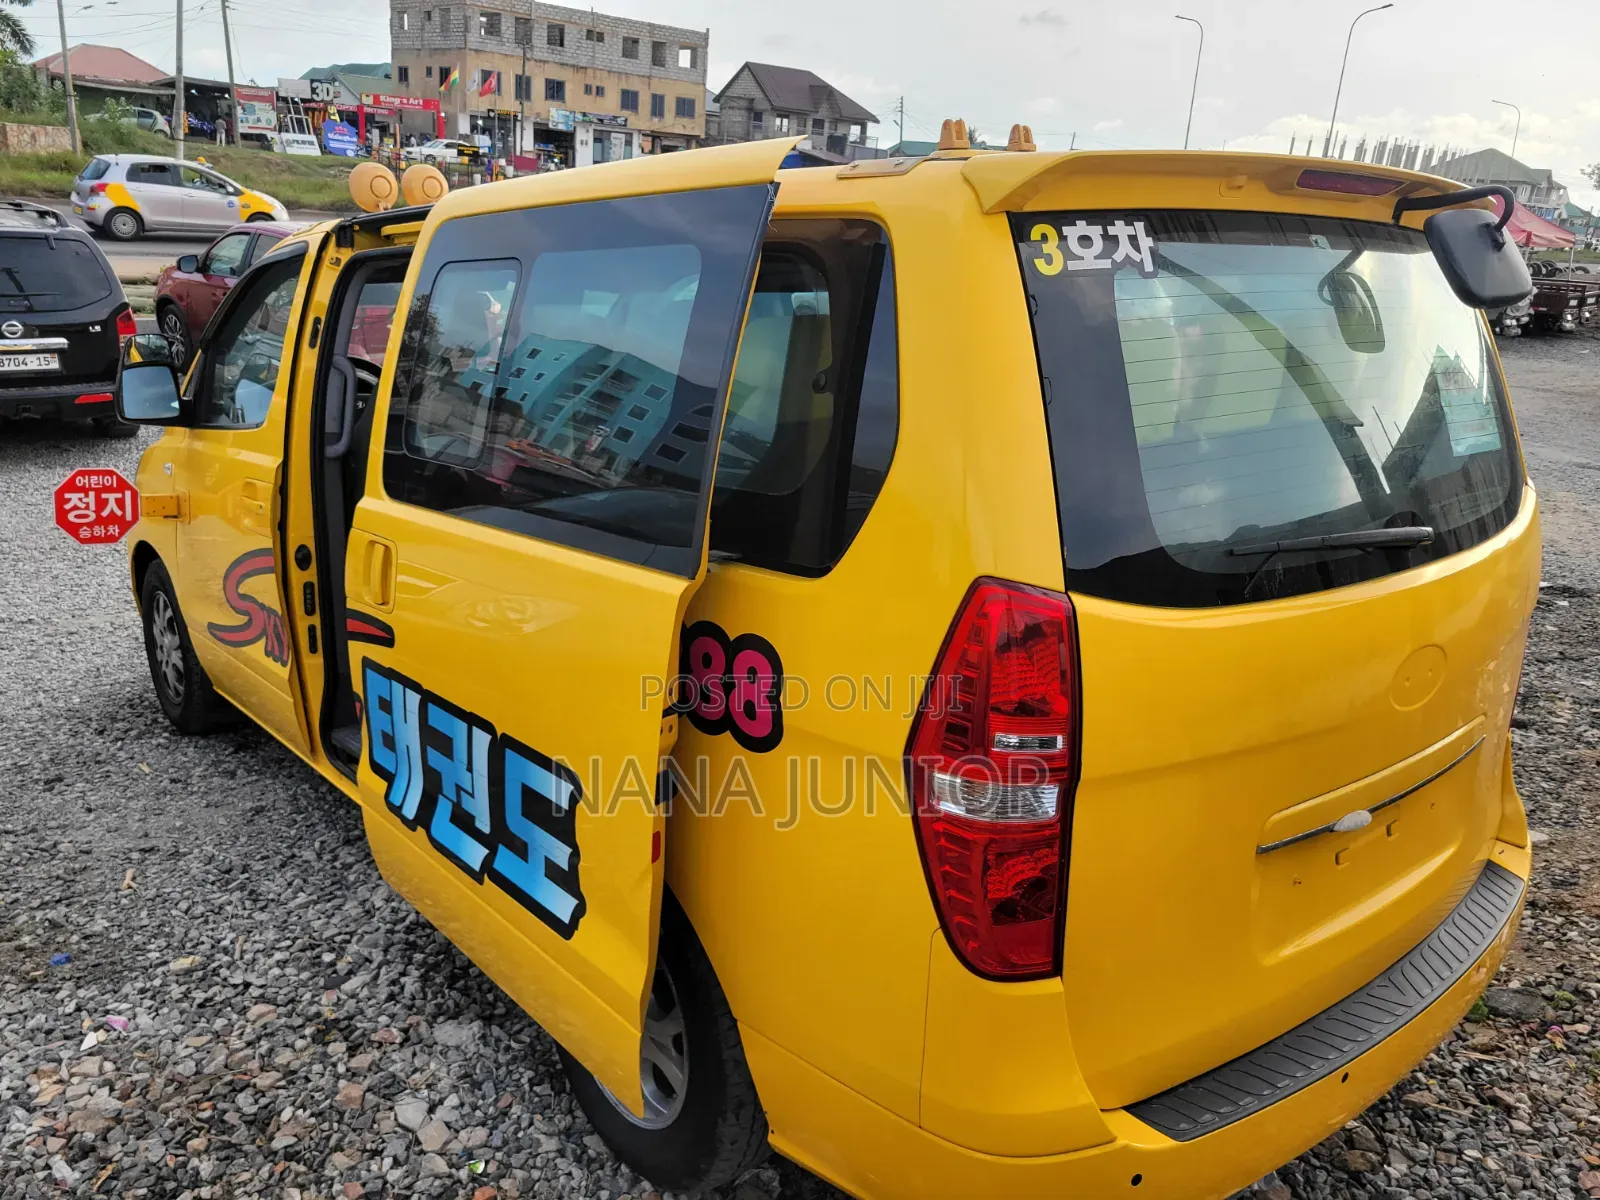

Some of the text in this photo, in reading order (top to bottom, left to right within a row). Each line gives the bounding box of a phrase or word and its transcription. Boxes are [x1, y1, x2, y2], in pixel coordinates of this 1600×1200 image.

[312, 81, 334, 101] 3D
[379, 95, 408, 105] King's
[409, 97, 423, 106] Art
[1029, 220, 1155, 276] 3호차
[75, 474, 118, 489] 어린이
[63, 490, 134, 524] 정지
[78, 524, 121, 539] 승하차
[362, 658, 585, 936] 태권도
